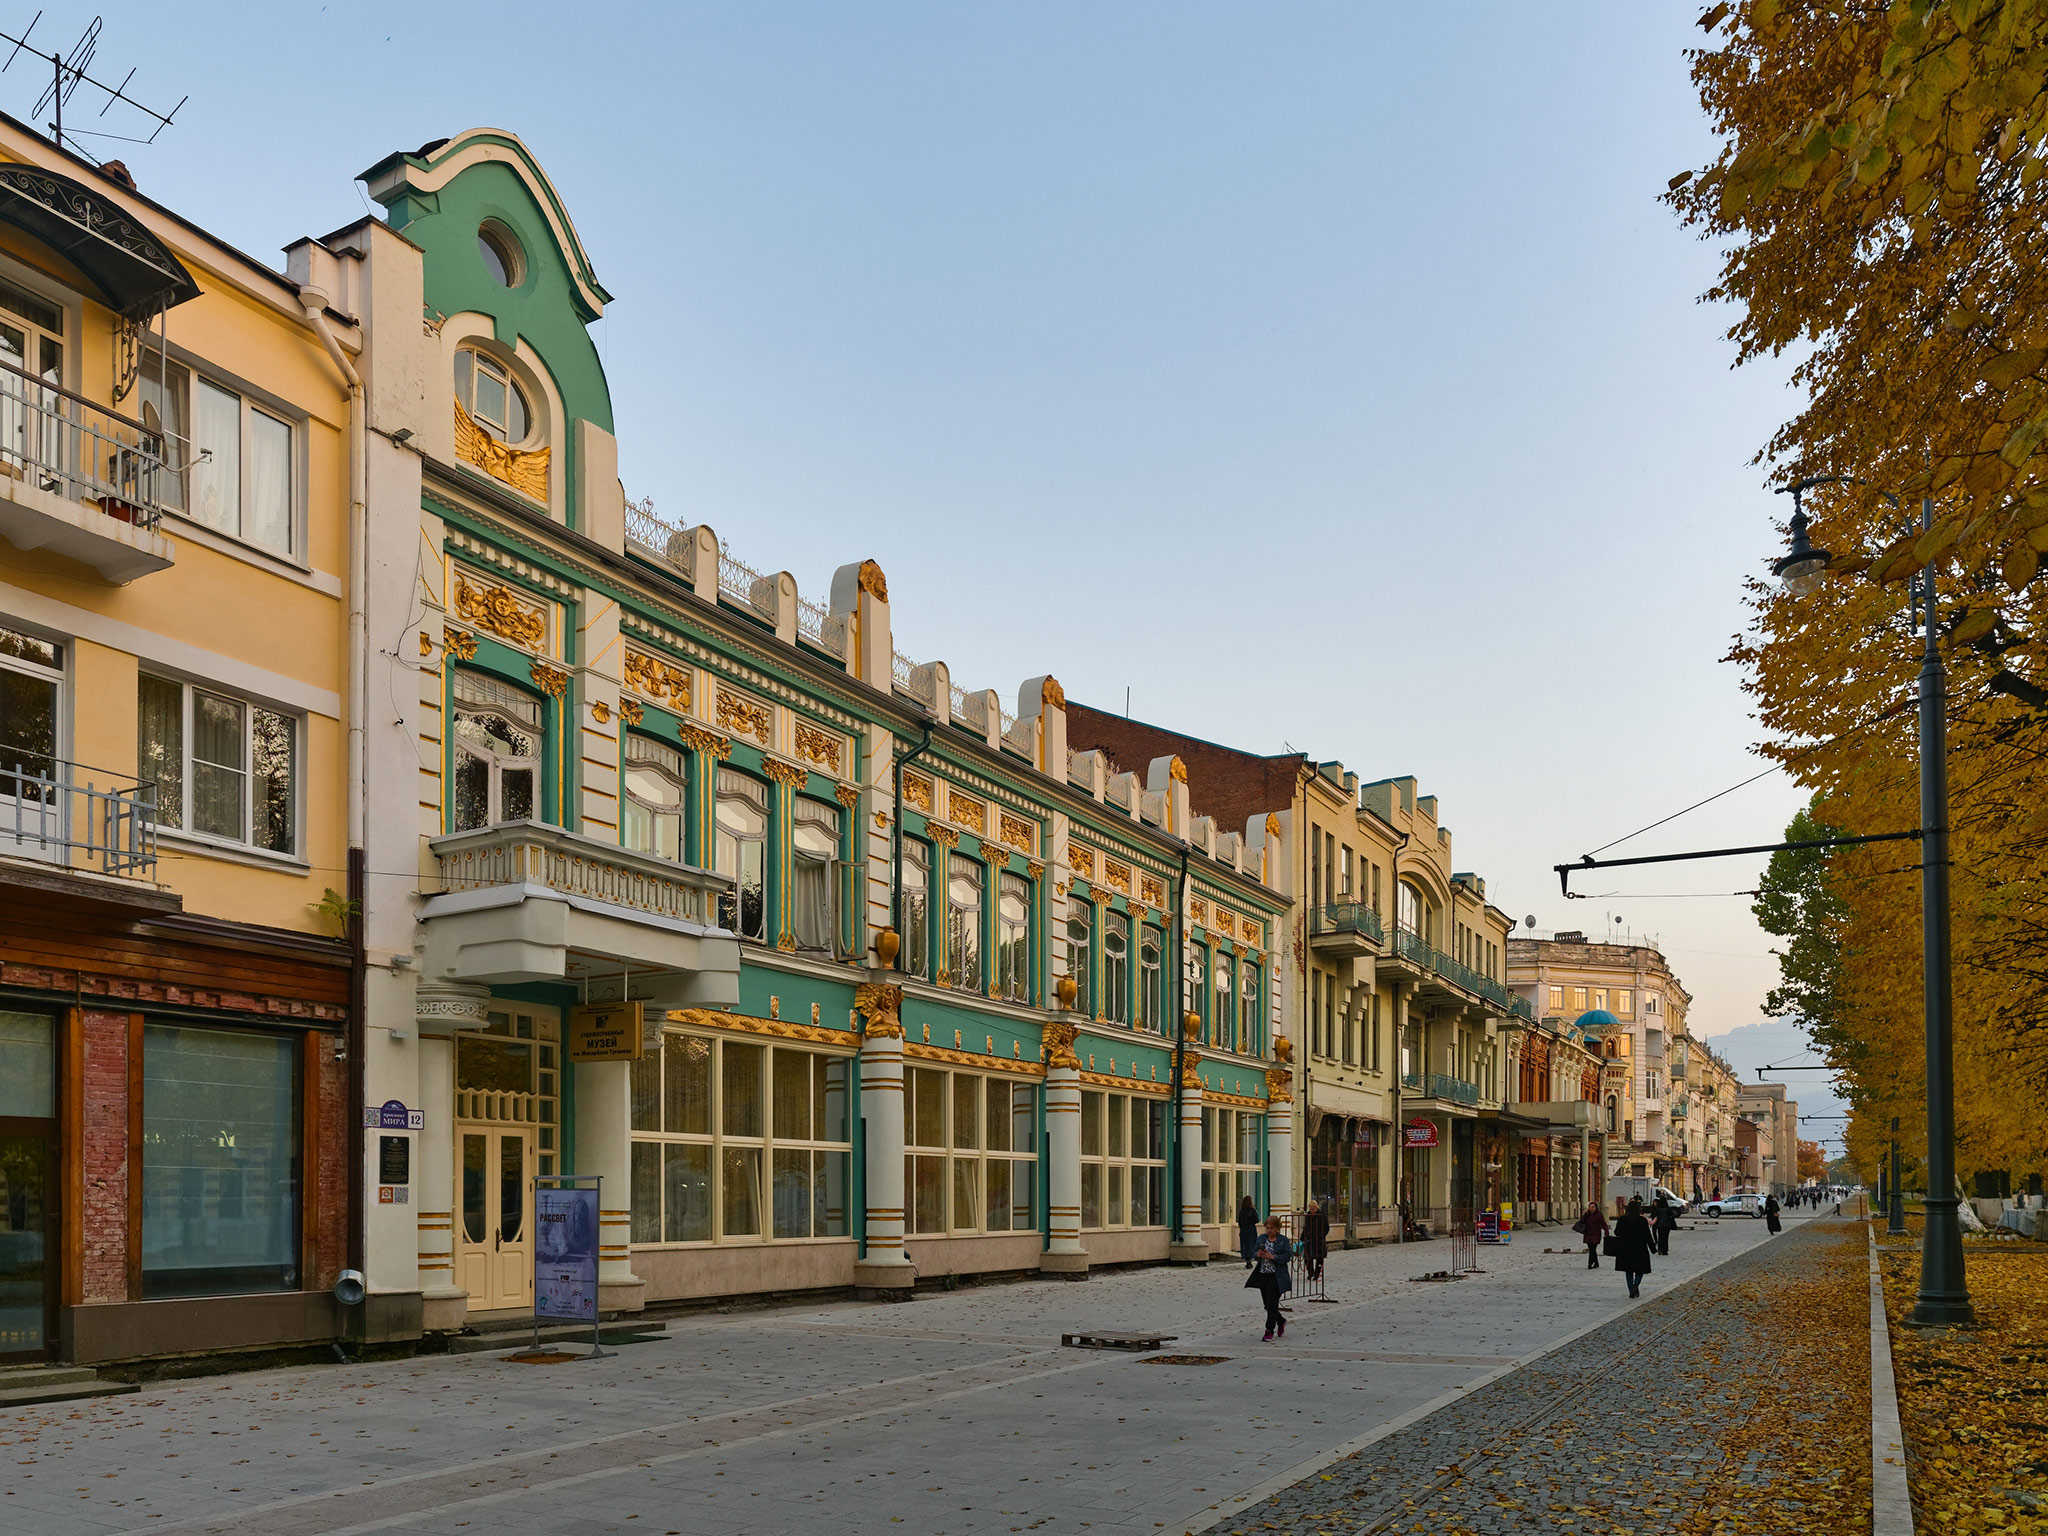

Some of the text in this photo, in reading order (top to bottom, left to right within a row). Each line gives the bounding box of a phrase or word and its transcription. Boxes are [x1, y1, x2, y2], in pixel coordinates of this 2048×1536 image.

[587, 1037, 617, 1048] МУЗЕЙ
[411, 1115, 421, 1125] 12
[539, 1213, 567, 1223] РАССВЕТ
